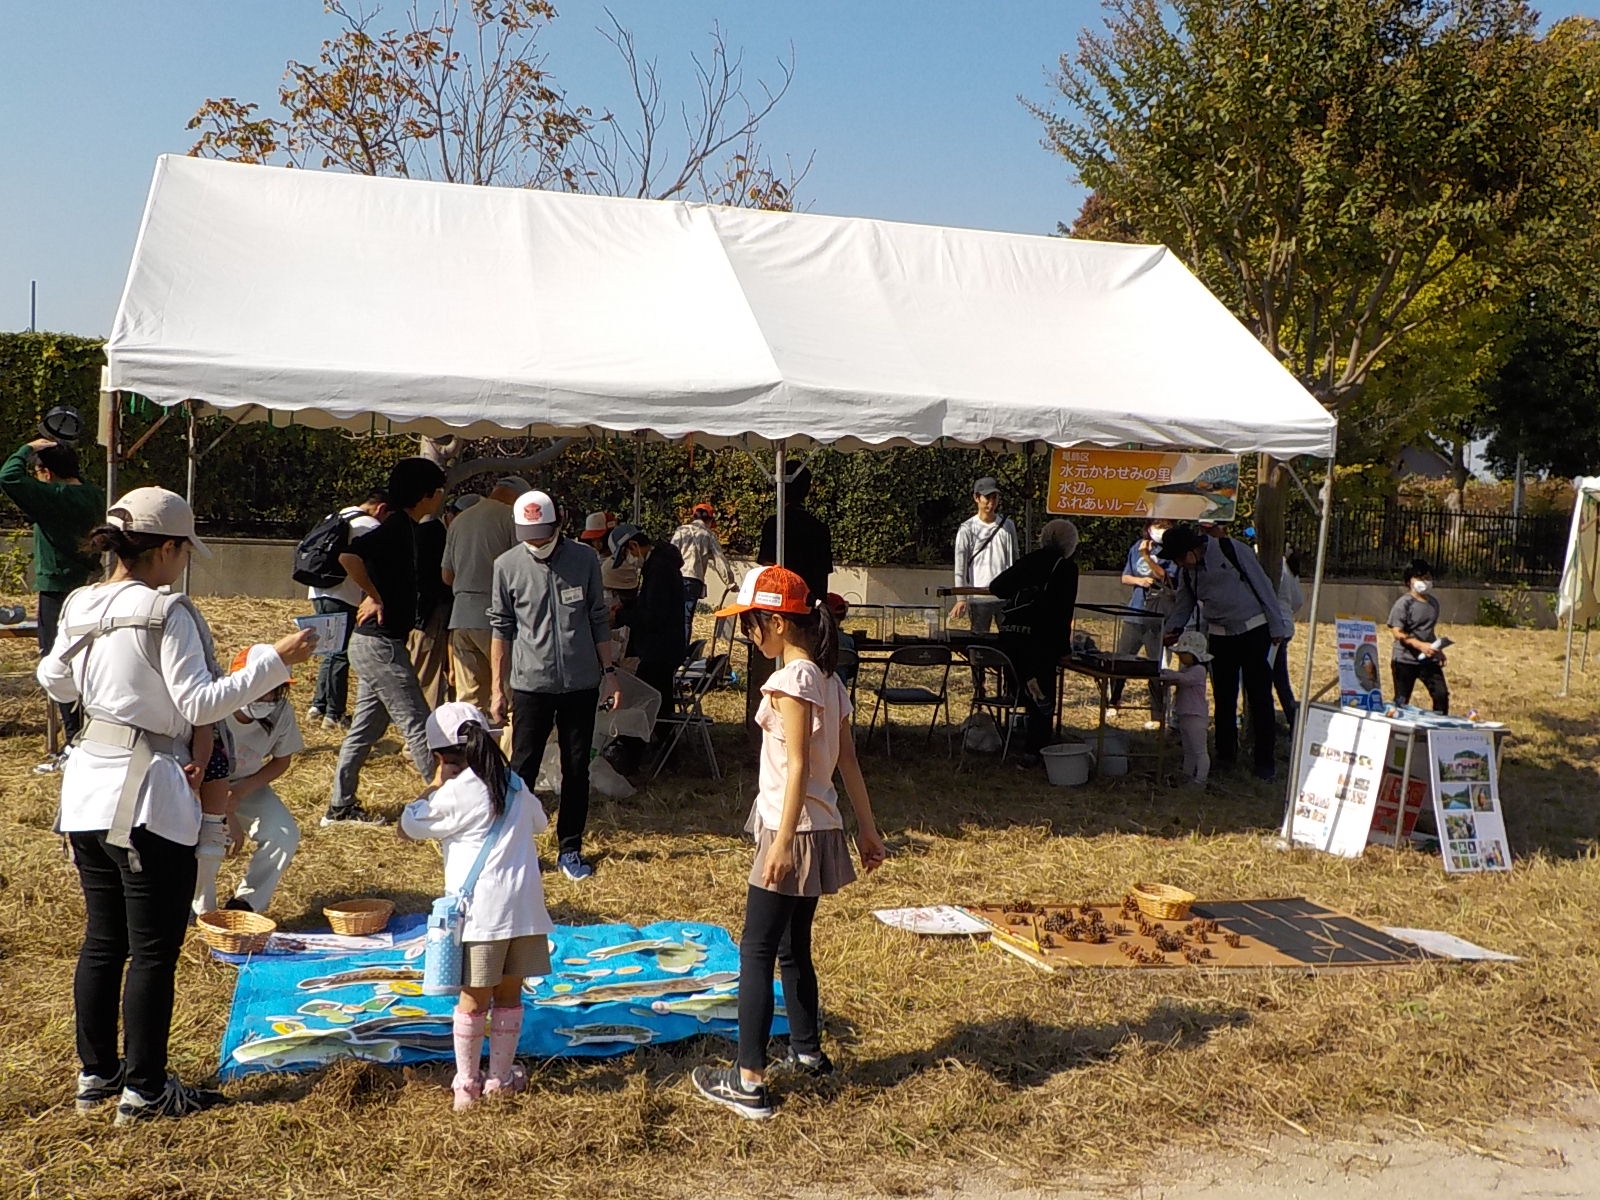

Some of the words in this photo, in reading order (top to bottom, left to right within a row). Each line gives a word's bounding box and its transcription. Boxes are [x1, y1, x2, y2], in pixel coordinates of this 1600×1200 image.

[1060, 464, 1171, 482] 水元かわせみの里
[1058, 481, 1094, 495] 水辺の
[1057, 496, 1147, 512] ふれあいルーム
